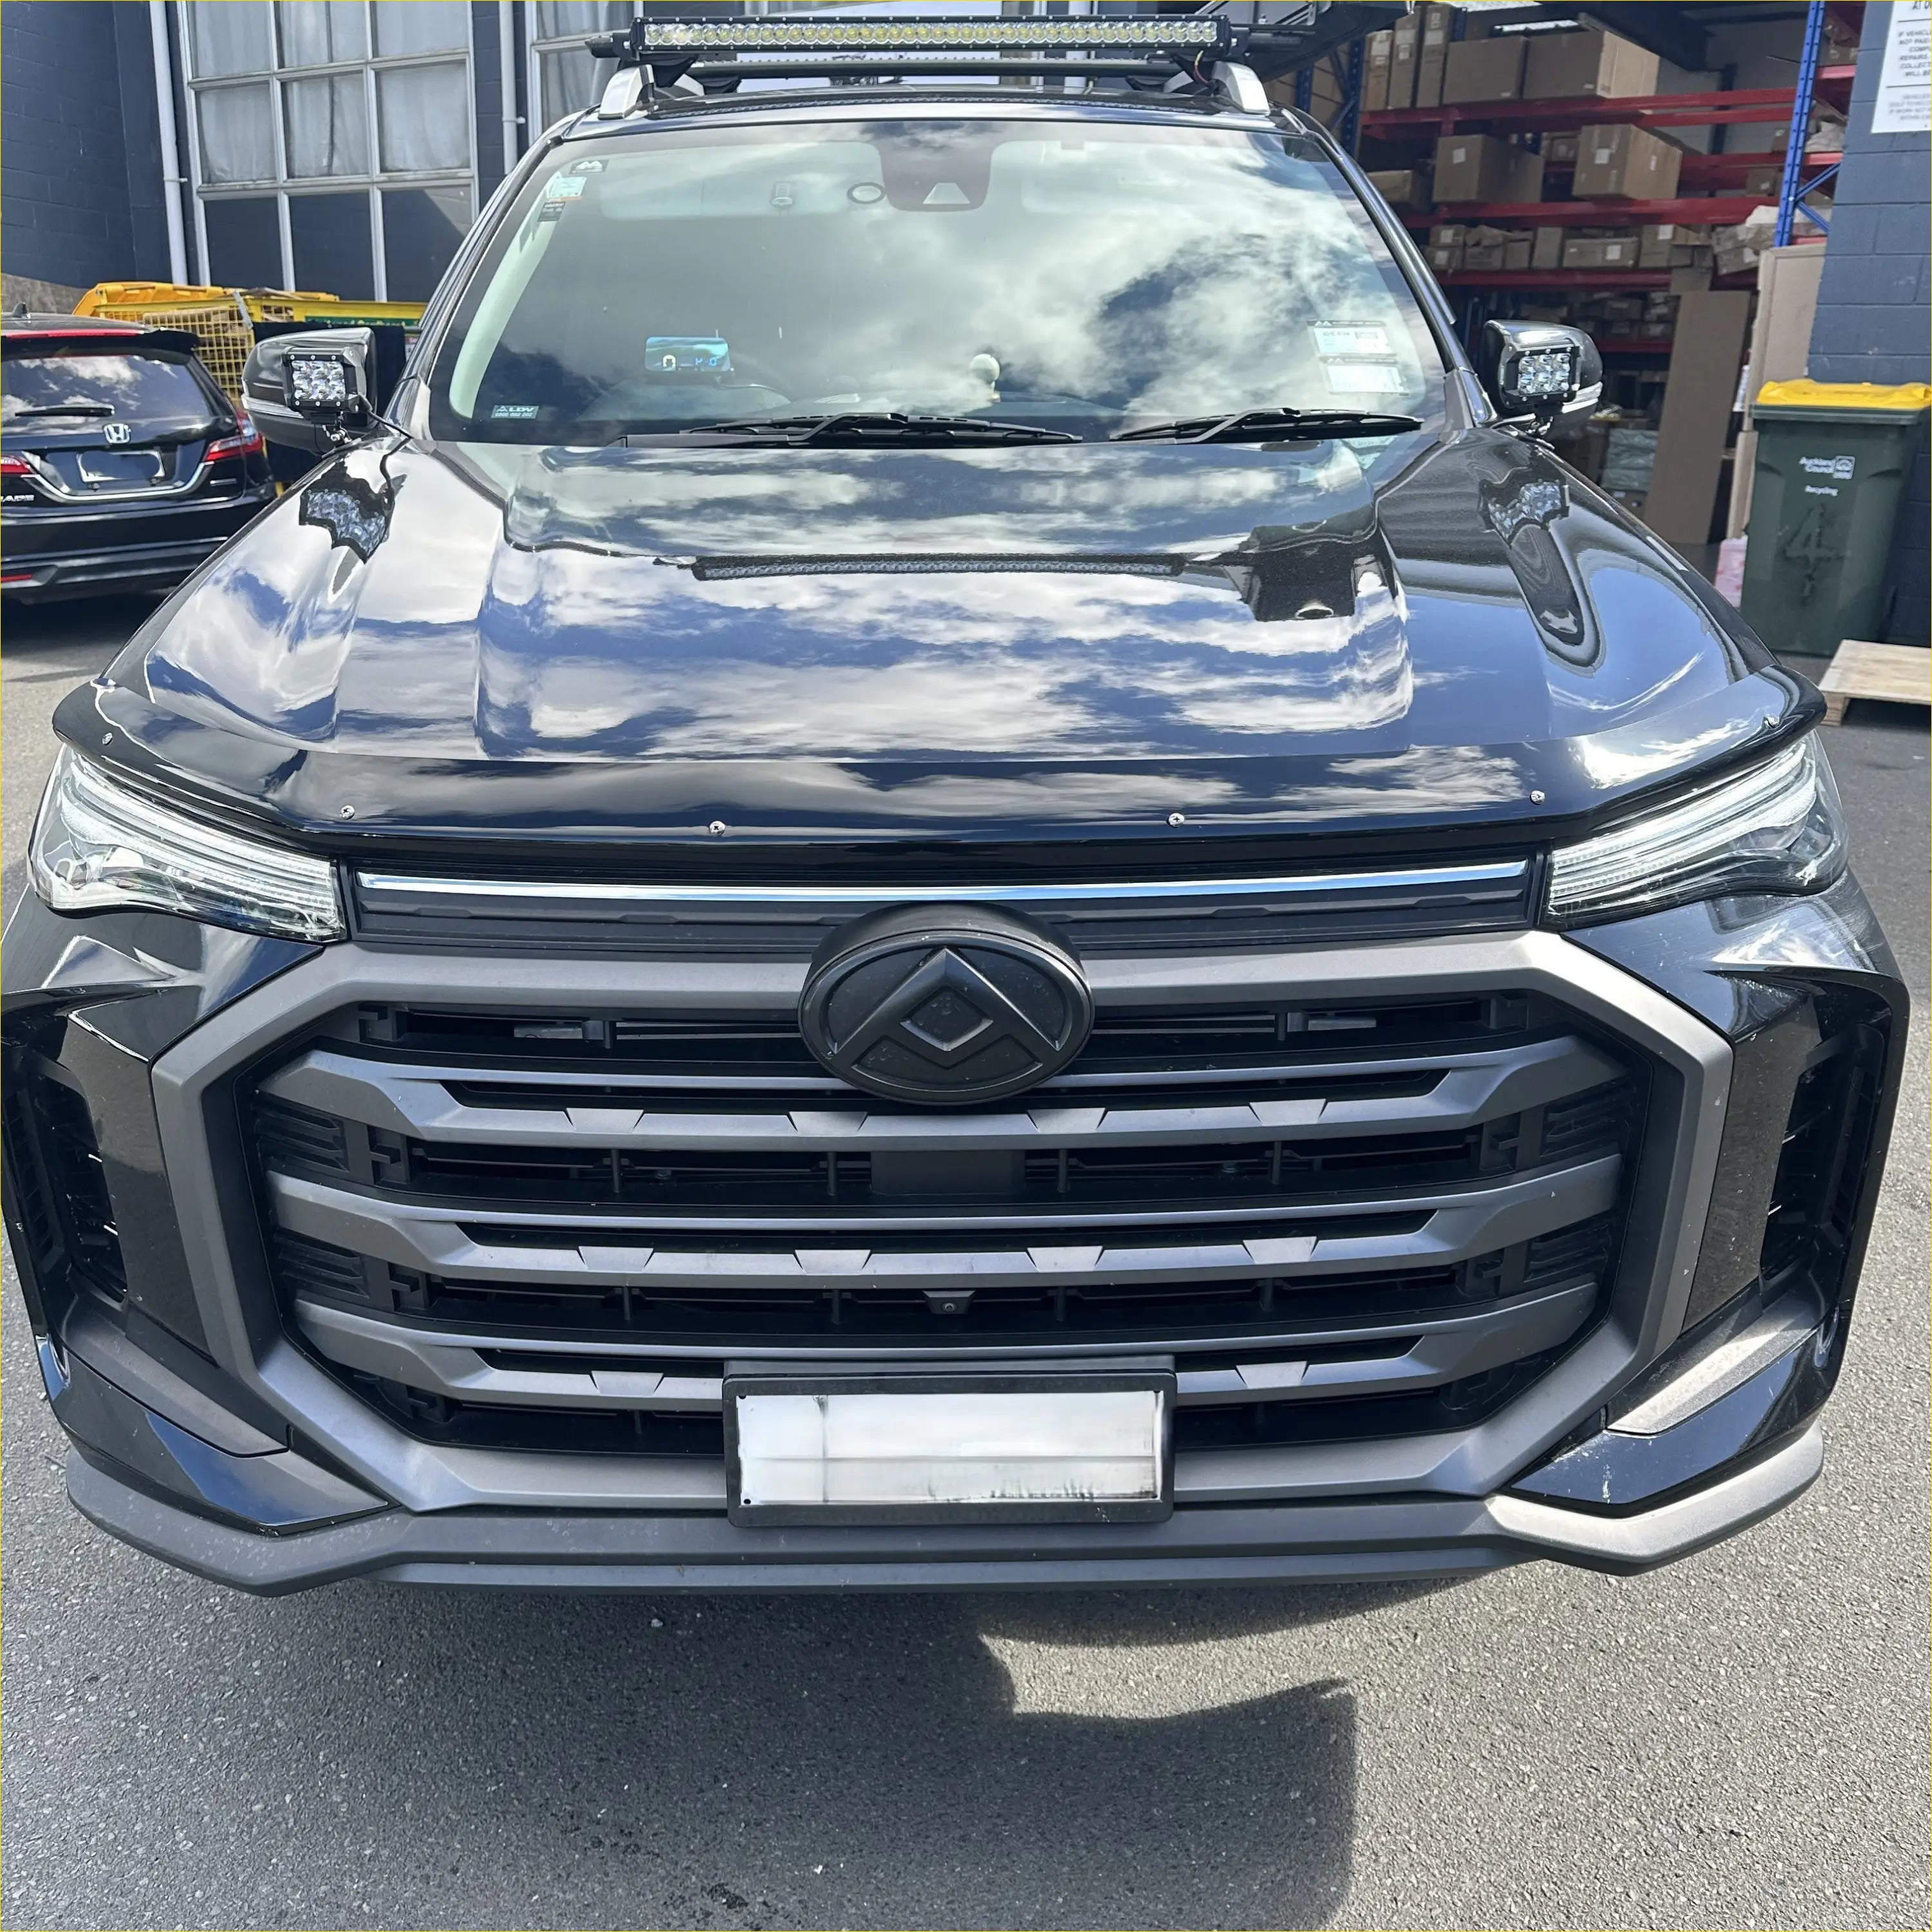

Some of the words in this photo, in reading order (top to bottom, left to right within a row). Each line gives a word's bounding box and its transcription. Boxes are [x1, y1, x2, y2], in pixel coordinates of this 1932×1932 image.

[1799, 456, 1836, 467] Auckland
[1805, 465, 1834, 474] Council
[1805, 485, 1839, 497] Recycling
